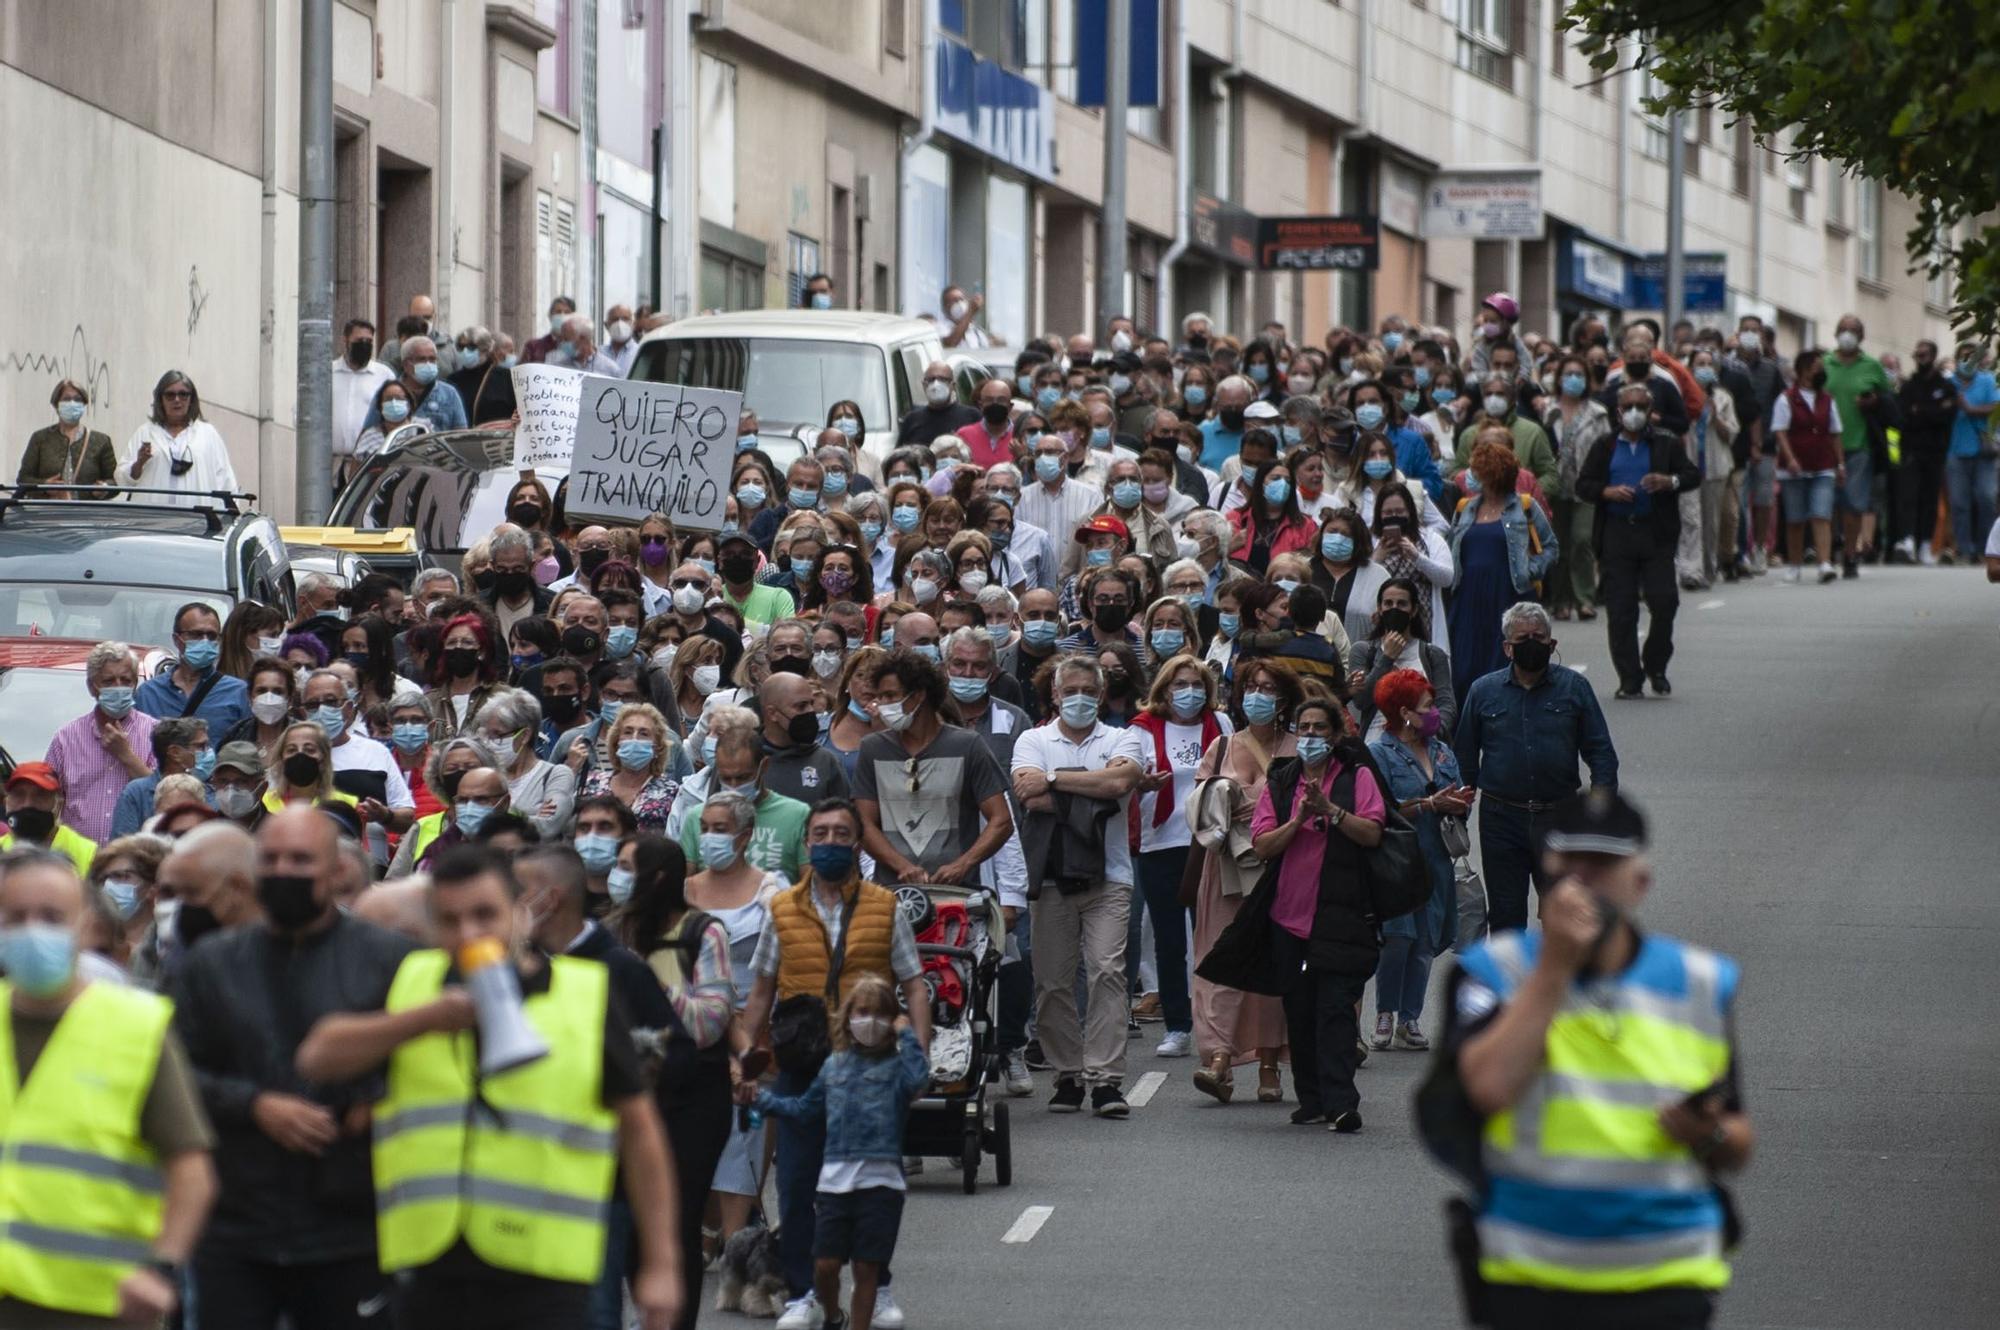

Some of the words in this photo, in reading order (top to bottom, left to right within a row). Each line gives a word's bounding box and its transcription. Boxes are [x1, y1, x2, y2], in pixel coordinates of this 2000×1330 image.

[595, 387, 727, 441] QUIERO
[530, 435, 562, 450] STOP
[592, 430, 709, 476] JUGAR
[578, 470, 718, 517] TRANQUILO
